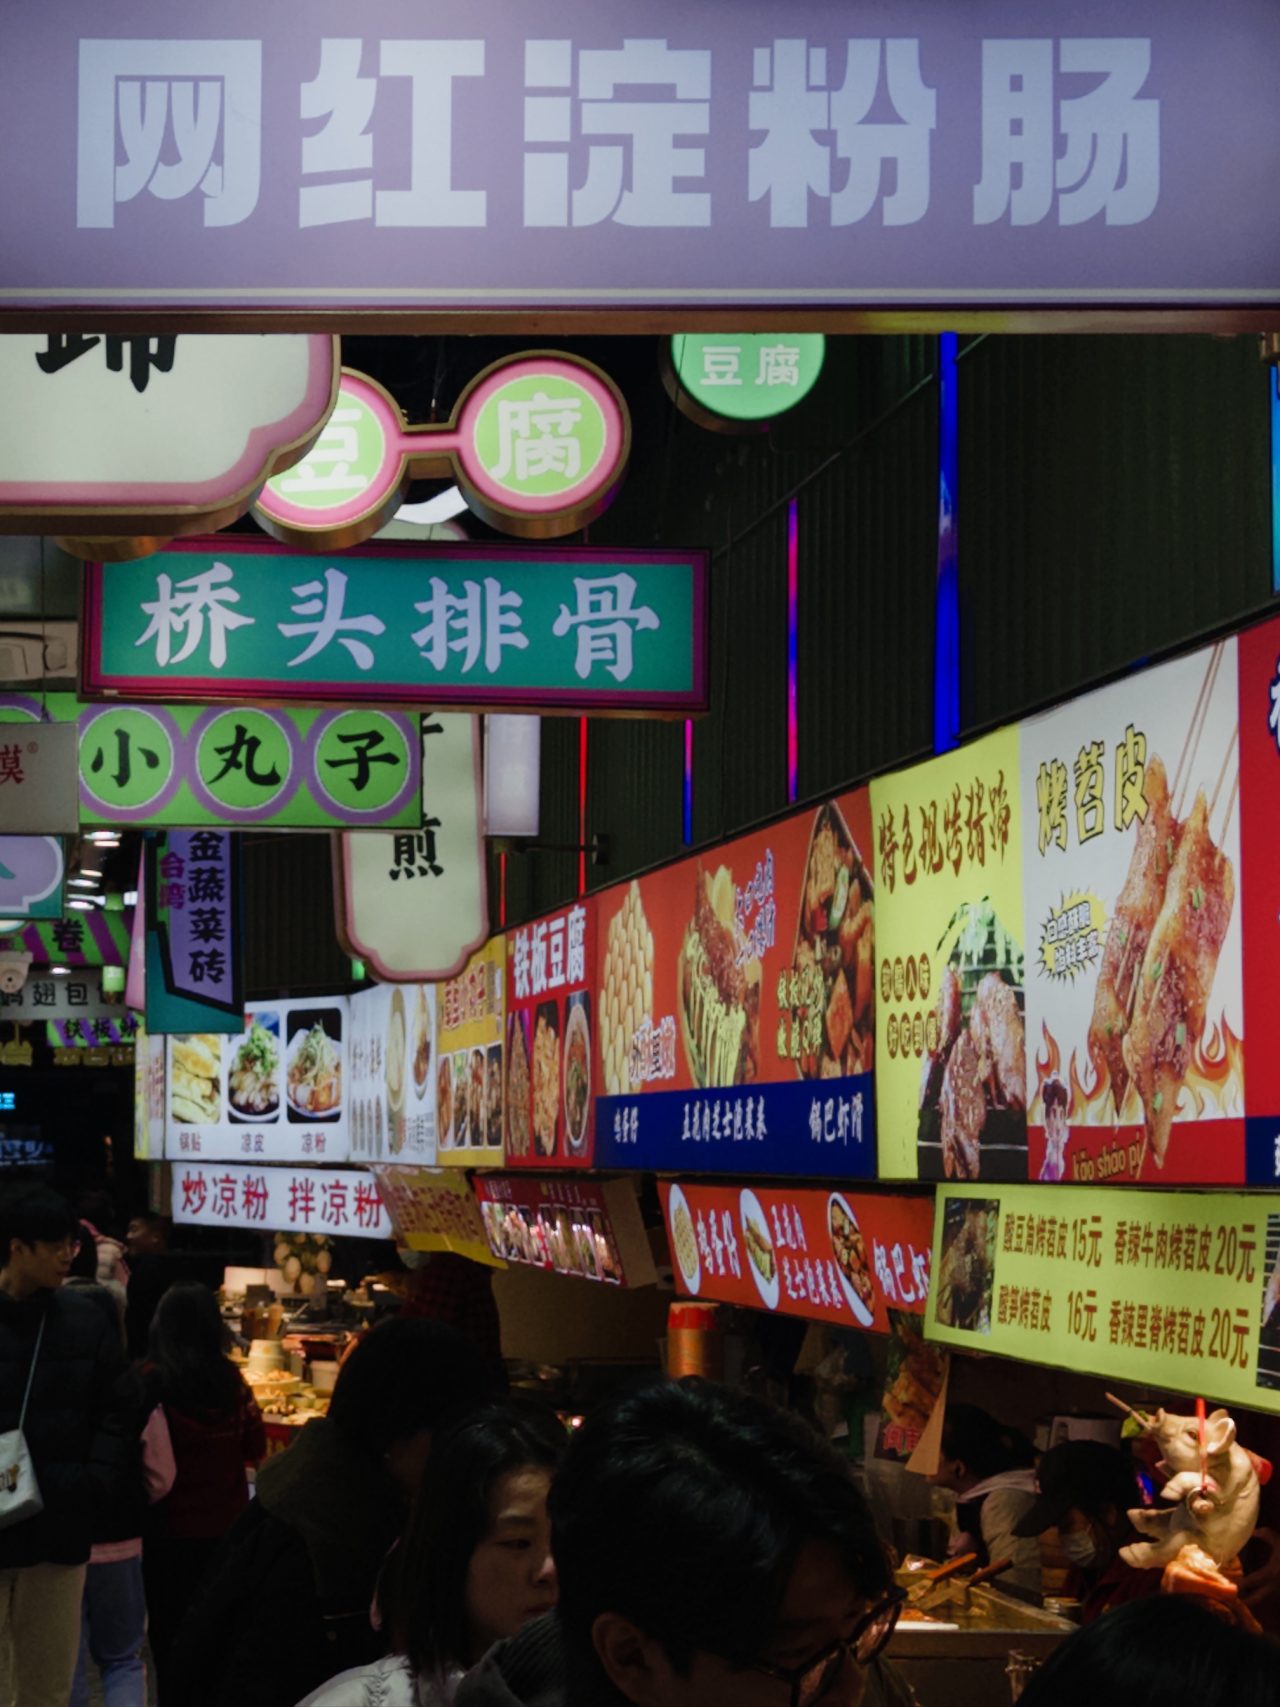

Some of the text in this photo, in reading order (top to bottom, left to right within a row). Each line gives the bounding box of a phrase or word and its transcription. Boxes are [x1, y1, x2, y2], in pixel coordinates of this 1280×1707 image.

[76, 36, 1162, 230] 网红淀粉肠
[700, 344, 802, 389] 豆腐
[280, 391, 583, 493] 豆腐
[134, 561, 662, 682] 桥头排骨
[90, 724, 402, 792] 小丸子
[1035, 723, 1152, 859] 烤苕皮
[878, 769, 1013, 894] 特色现烤猪蹄
[159, 851, 186, 910] 台湾
[188, 830, 226, 985] 金蔬菜砖
[513, 905, 587, 999] 铁板豆腐
[181, 1170, 269, 1222] 炒凉粉
[288, 1176, 385, 1229] 拌凉粉
[872, 1236, 931, 1304] 锅巴虾
[1072, 1215, 1103, 1268] 15元
[1114, 1220, 1212, 1273] 香辣牛肉烤苕皮
[1214, 1223, 1258, 1284] 20元
[1067, 1289, 1099, 1343] 16元
[1109, 1300, 1207, 1359] 香辣里脊烤苕皮
[1208, 1307, 1251, 1369] 20元
